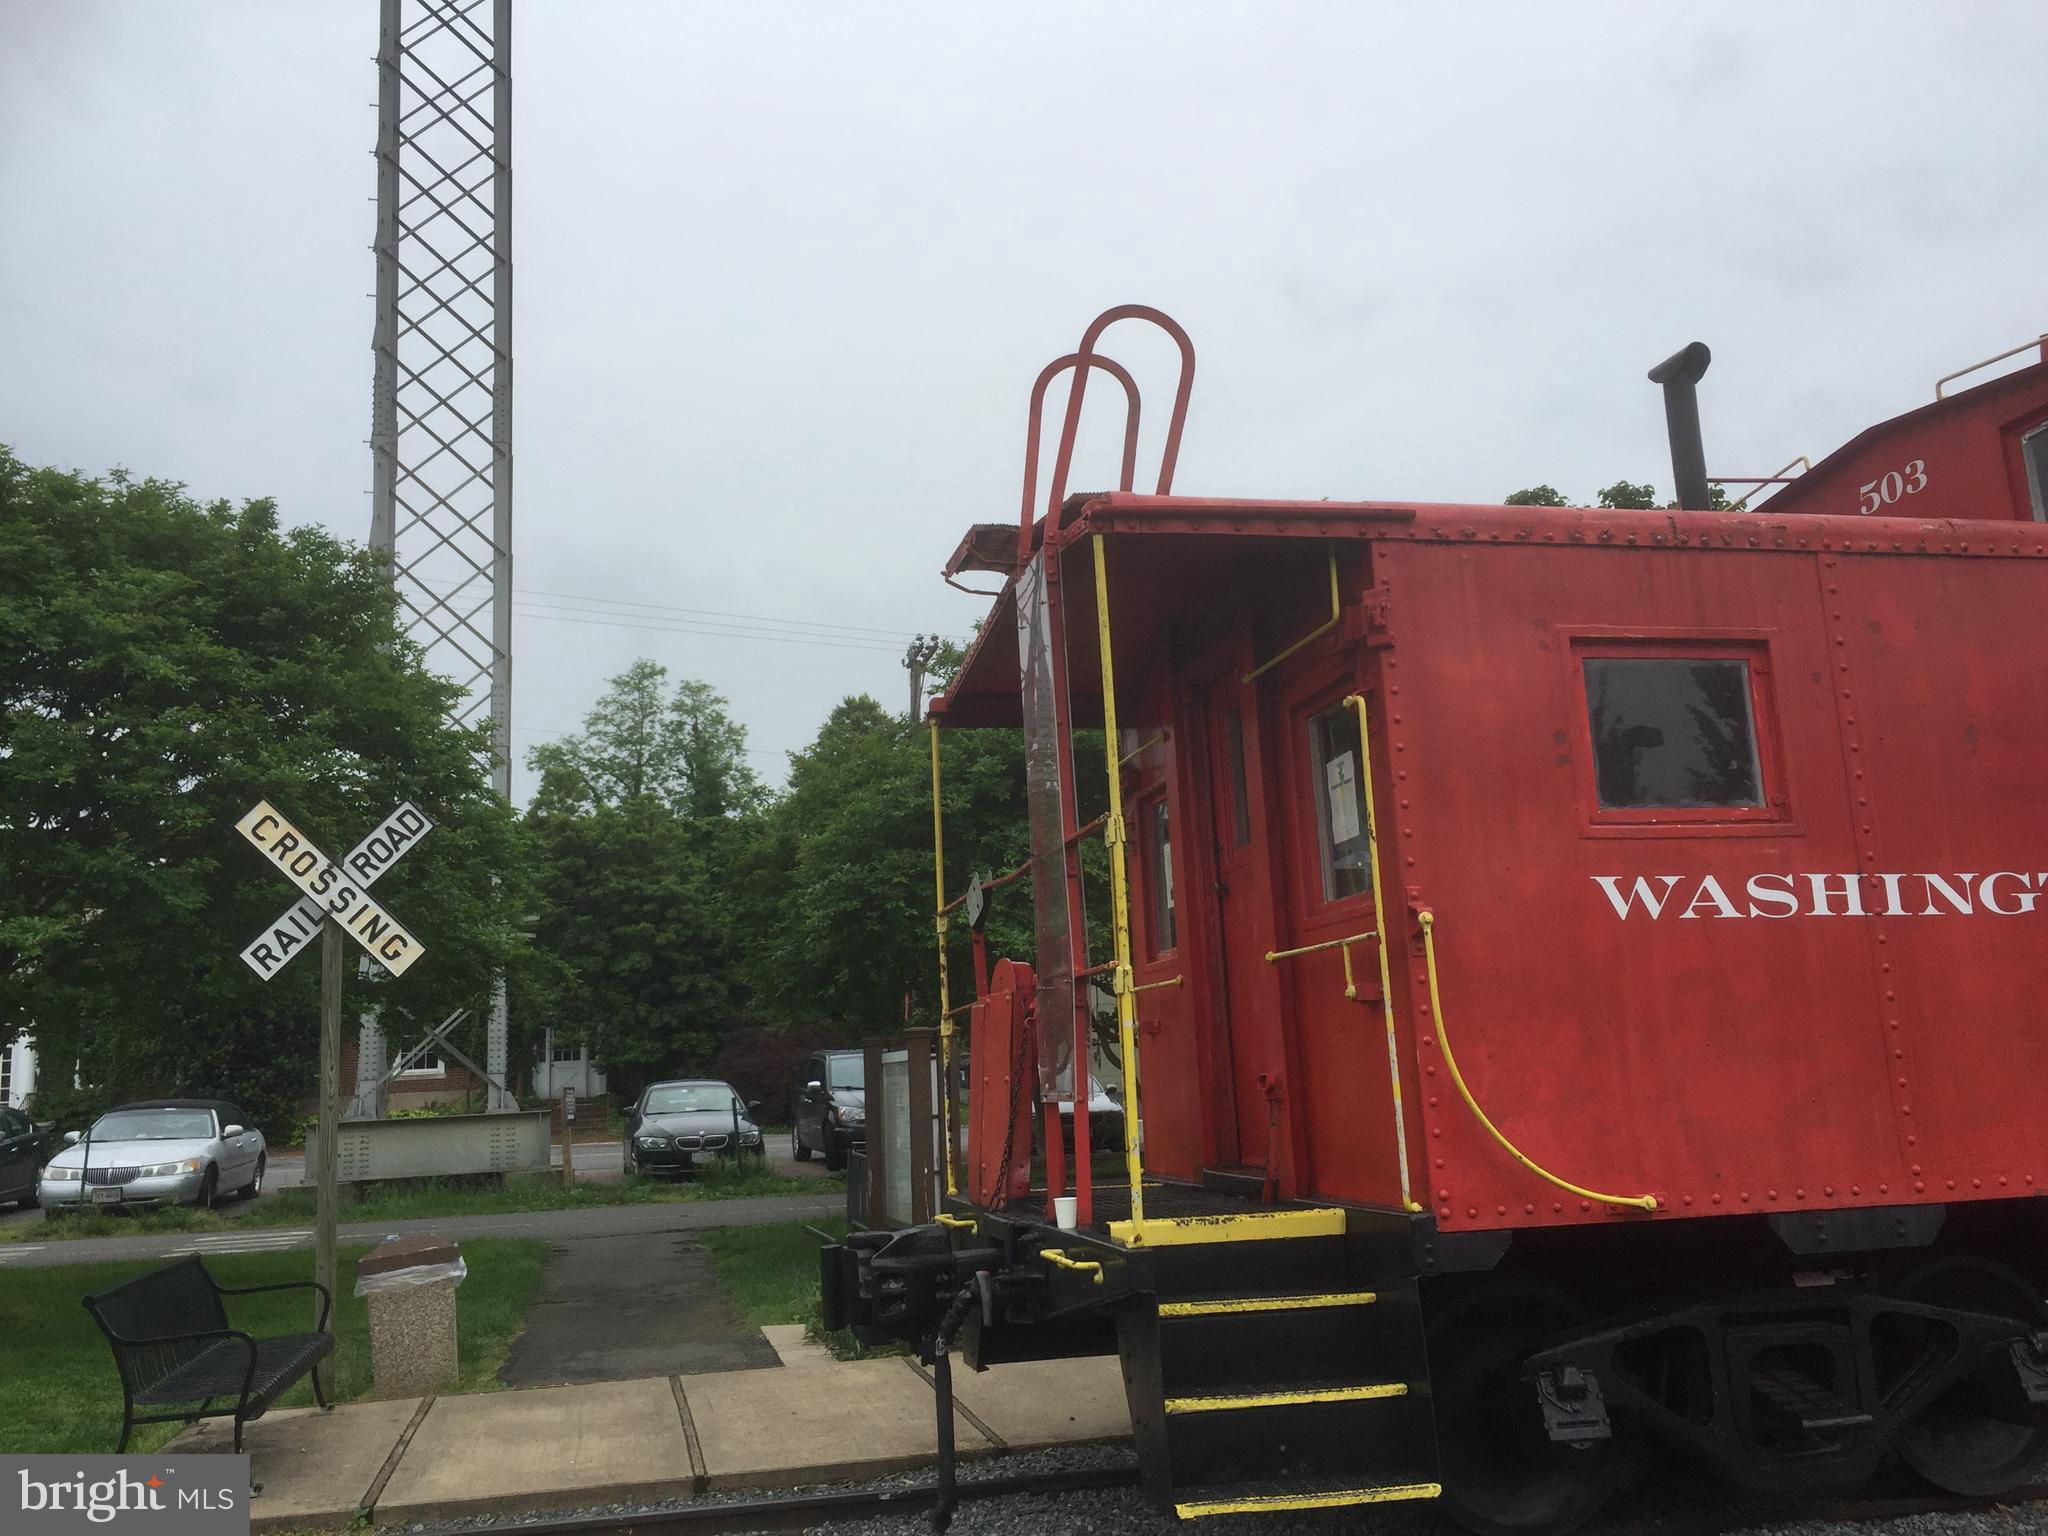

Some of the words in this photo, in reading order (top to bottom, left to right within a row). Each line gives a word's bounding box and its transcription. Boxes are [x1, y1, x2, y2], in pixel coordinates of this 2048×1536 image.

[1859, 459, 1928, 515] 503
[249, 906, 327, 973] RAIL
[349, 808, 426, 881] ROAD
[251, 814, 409, 961] CROSSING
